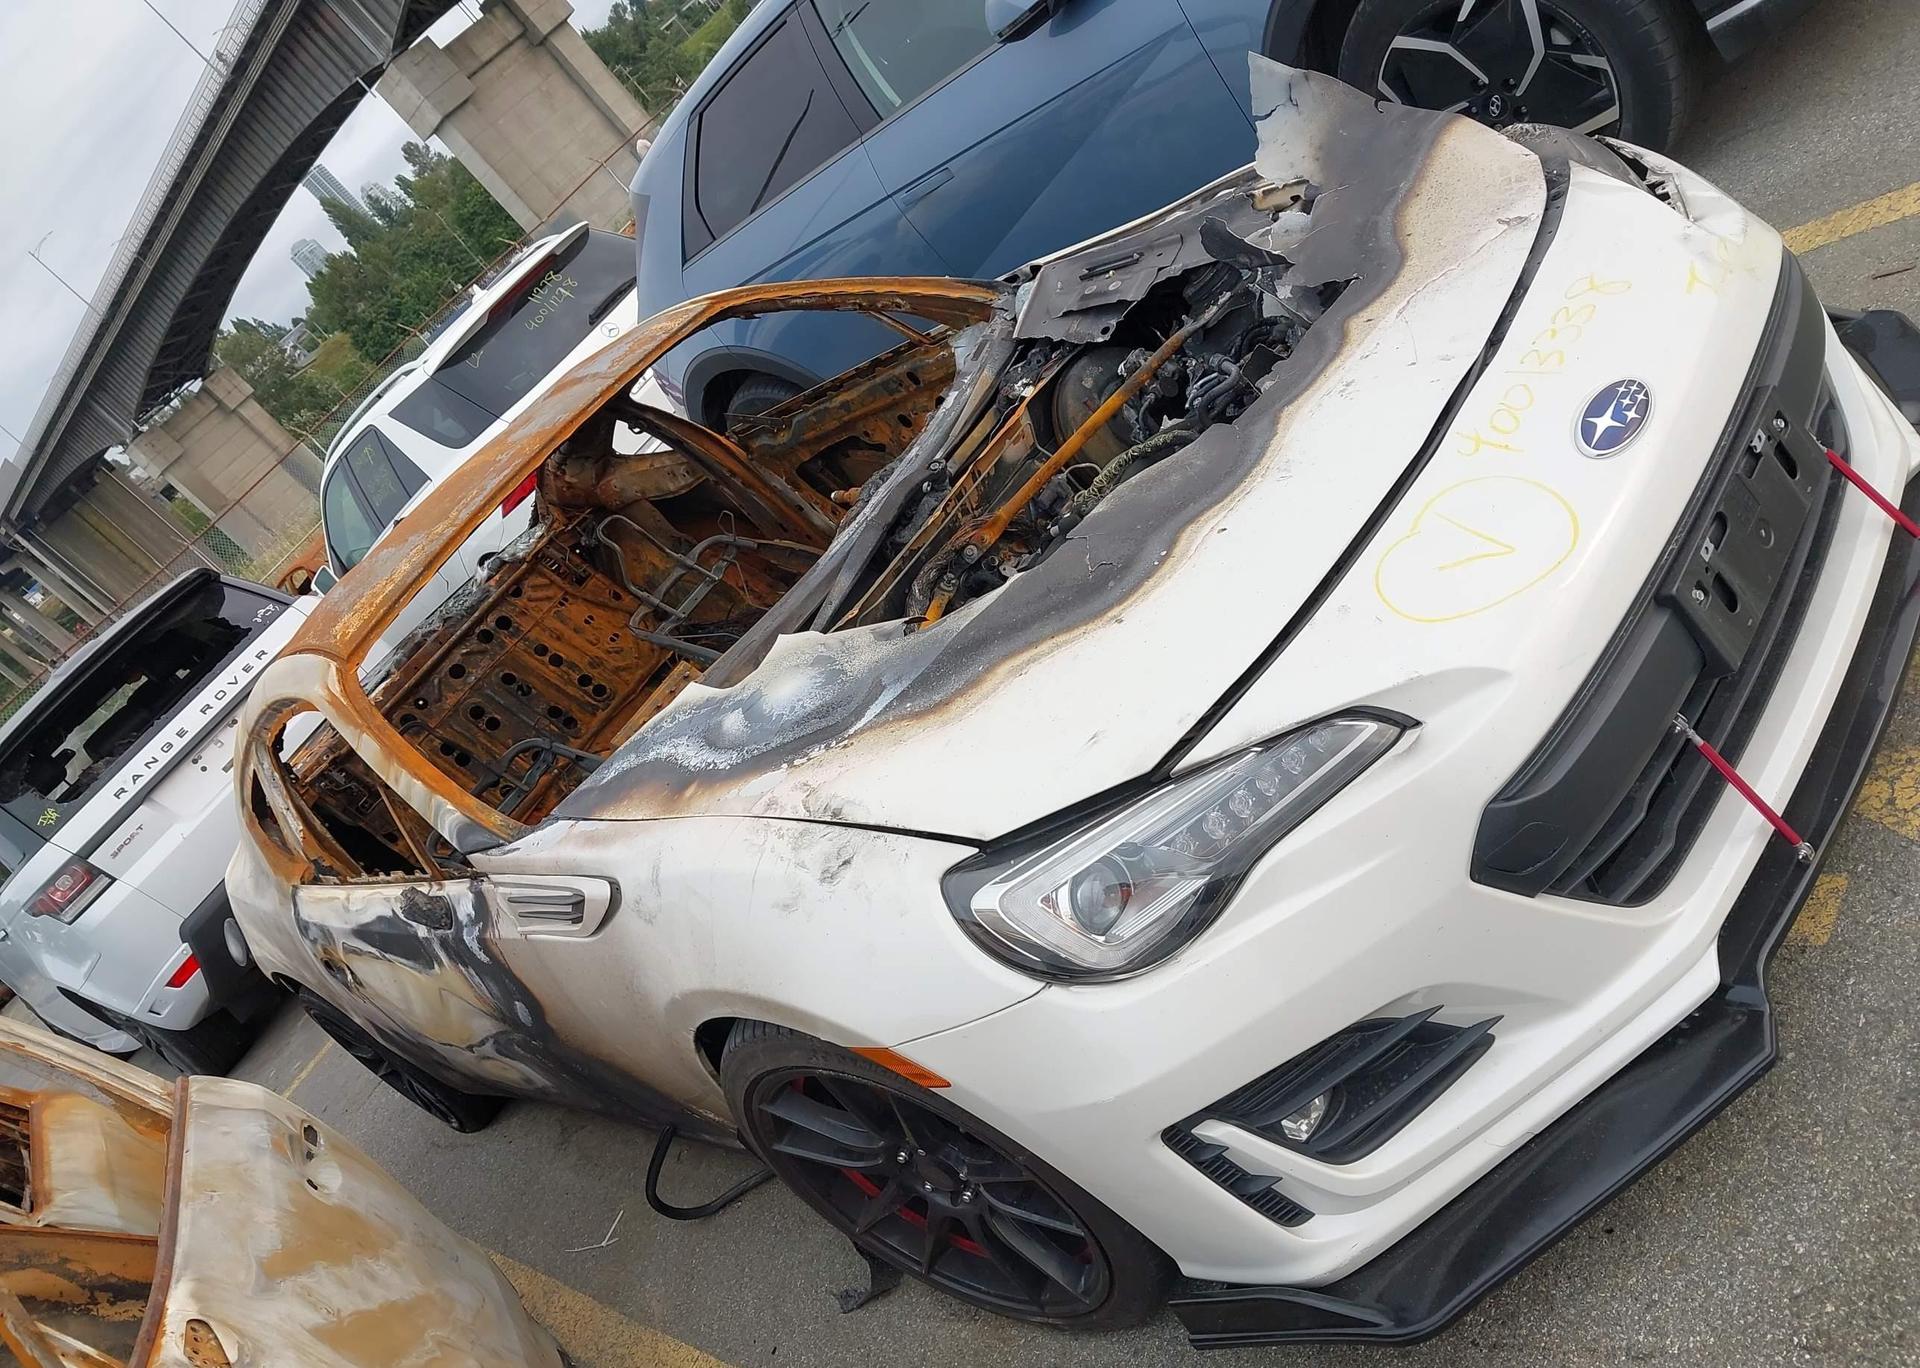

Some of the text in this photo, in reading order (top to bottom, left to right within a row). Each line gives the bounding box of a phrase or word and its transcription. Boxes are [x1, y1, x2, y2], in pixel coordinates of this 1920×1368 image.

[528, 271, 562, 305] 11278
[113, 649, 269, 800] RANGE ROVER
[110, 823, 145, 860] SPORT
